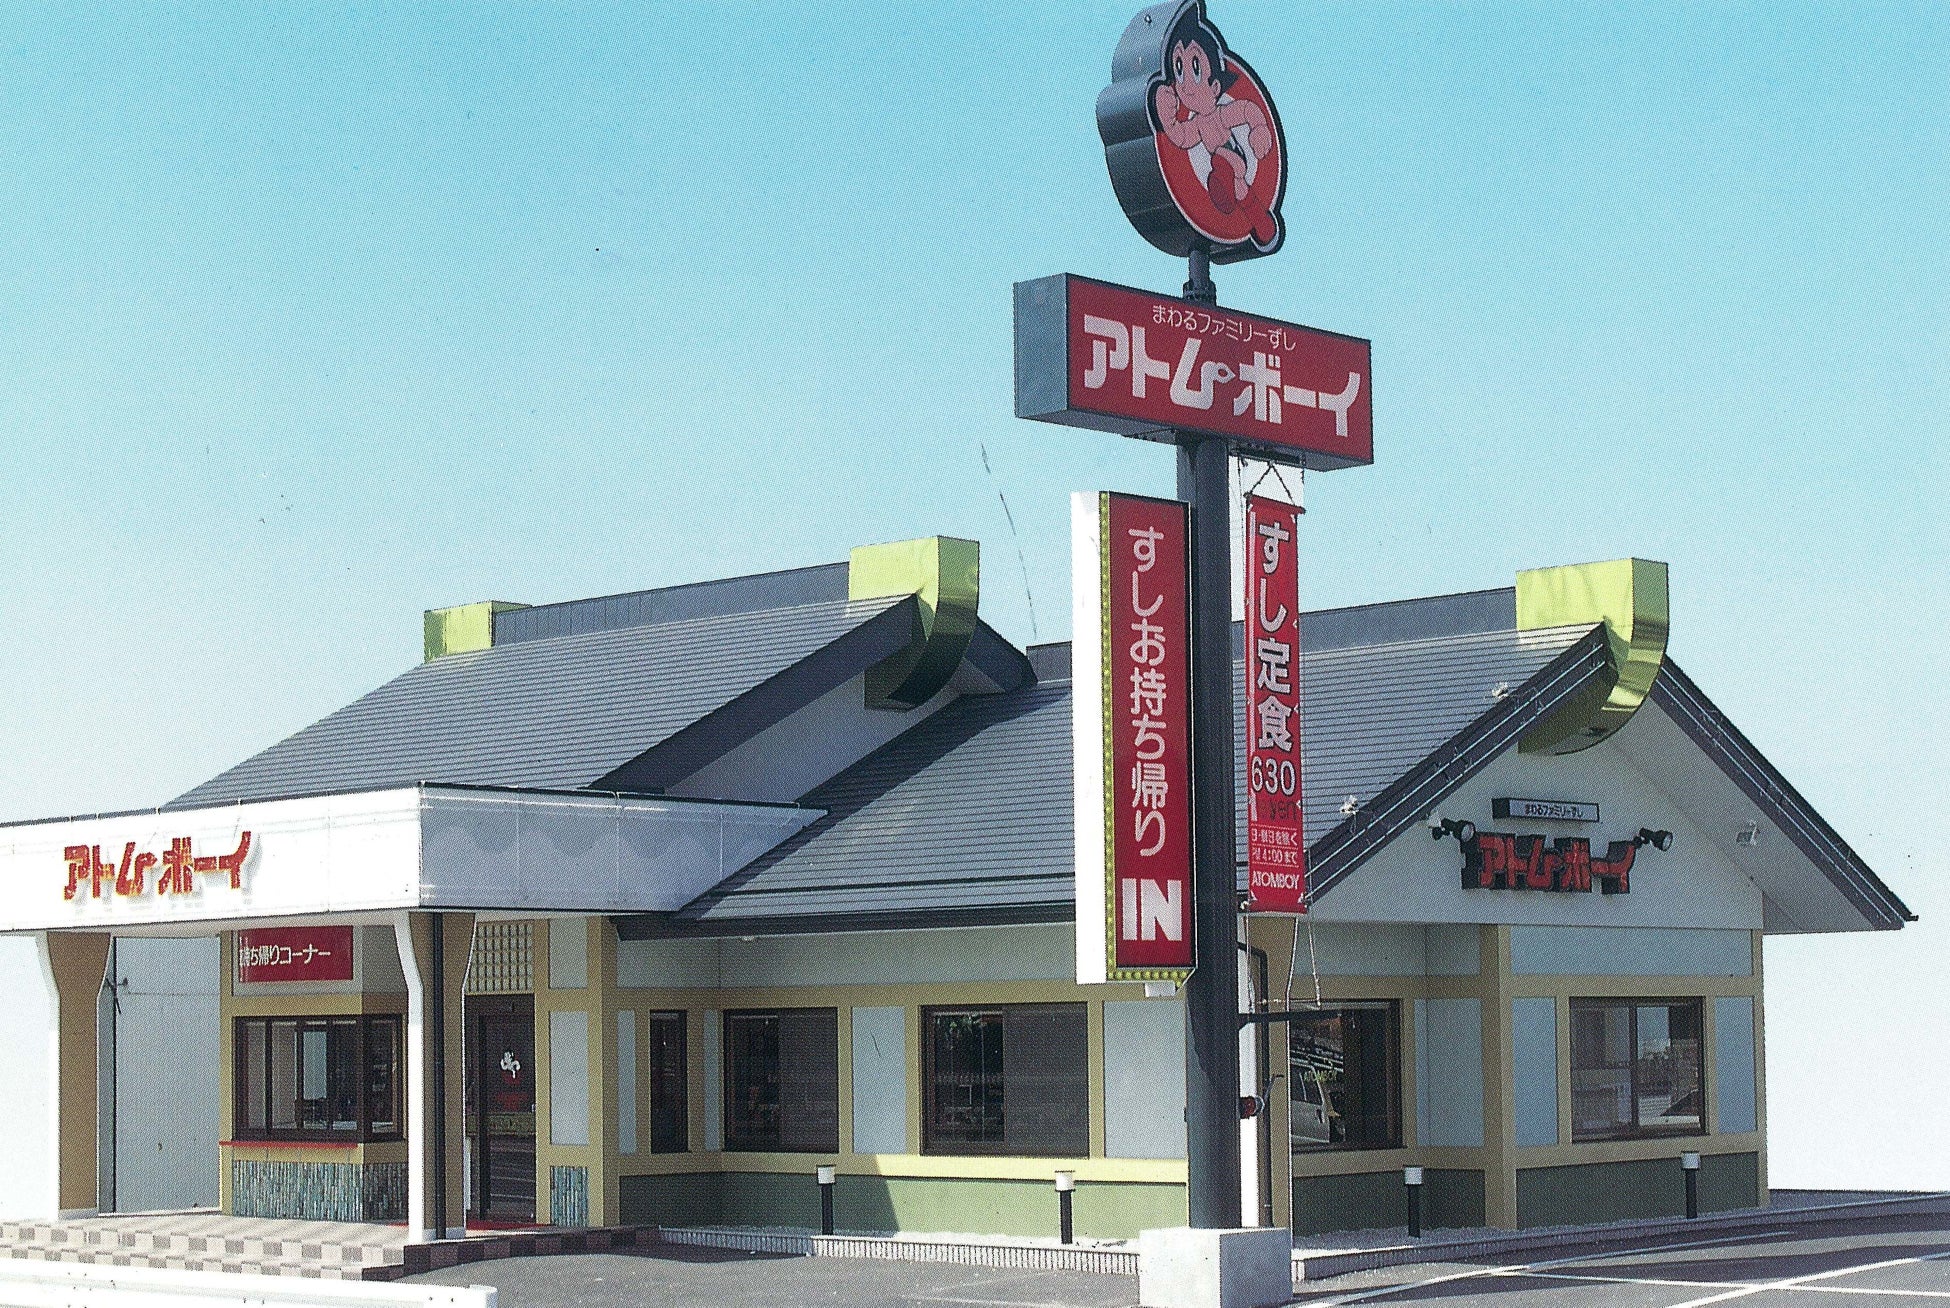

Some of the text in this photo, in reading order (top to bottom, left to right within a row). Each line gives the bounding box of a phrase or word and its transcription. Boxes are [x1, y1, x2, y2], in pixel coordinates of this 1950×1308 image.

[1083, 313, 1361, 438] アトムボーイ
[1257, 521, 1293, 753] すし定食
[1128, 525, 1168, 857] すしお持ち帰り
[1251, 755, 1296, 796] 630
[64, 830, 252, 901] アトムボーイ
[1251, 870, 1300, 890] ATOMBOY
[1479, 835, 1636, 893] アトムボーイ
[1122, 878, 1183, 942] IN
